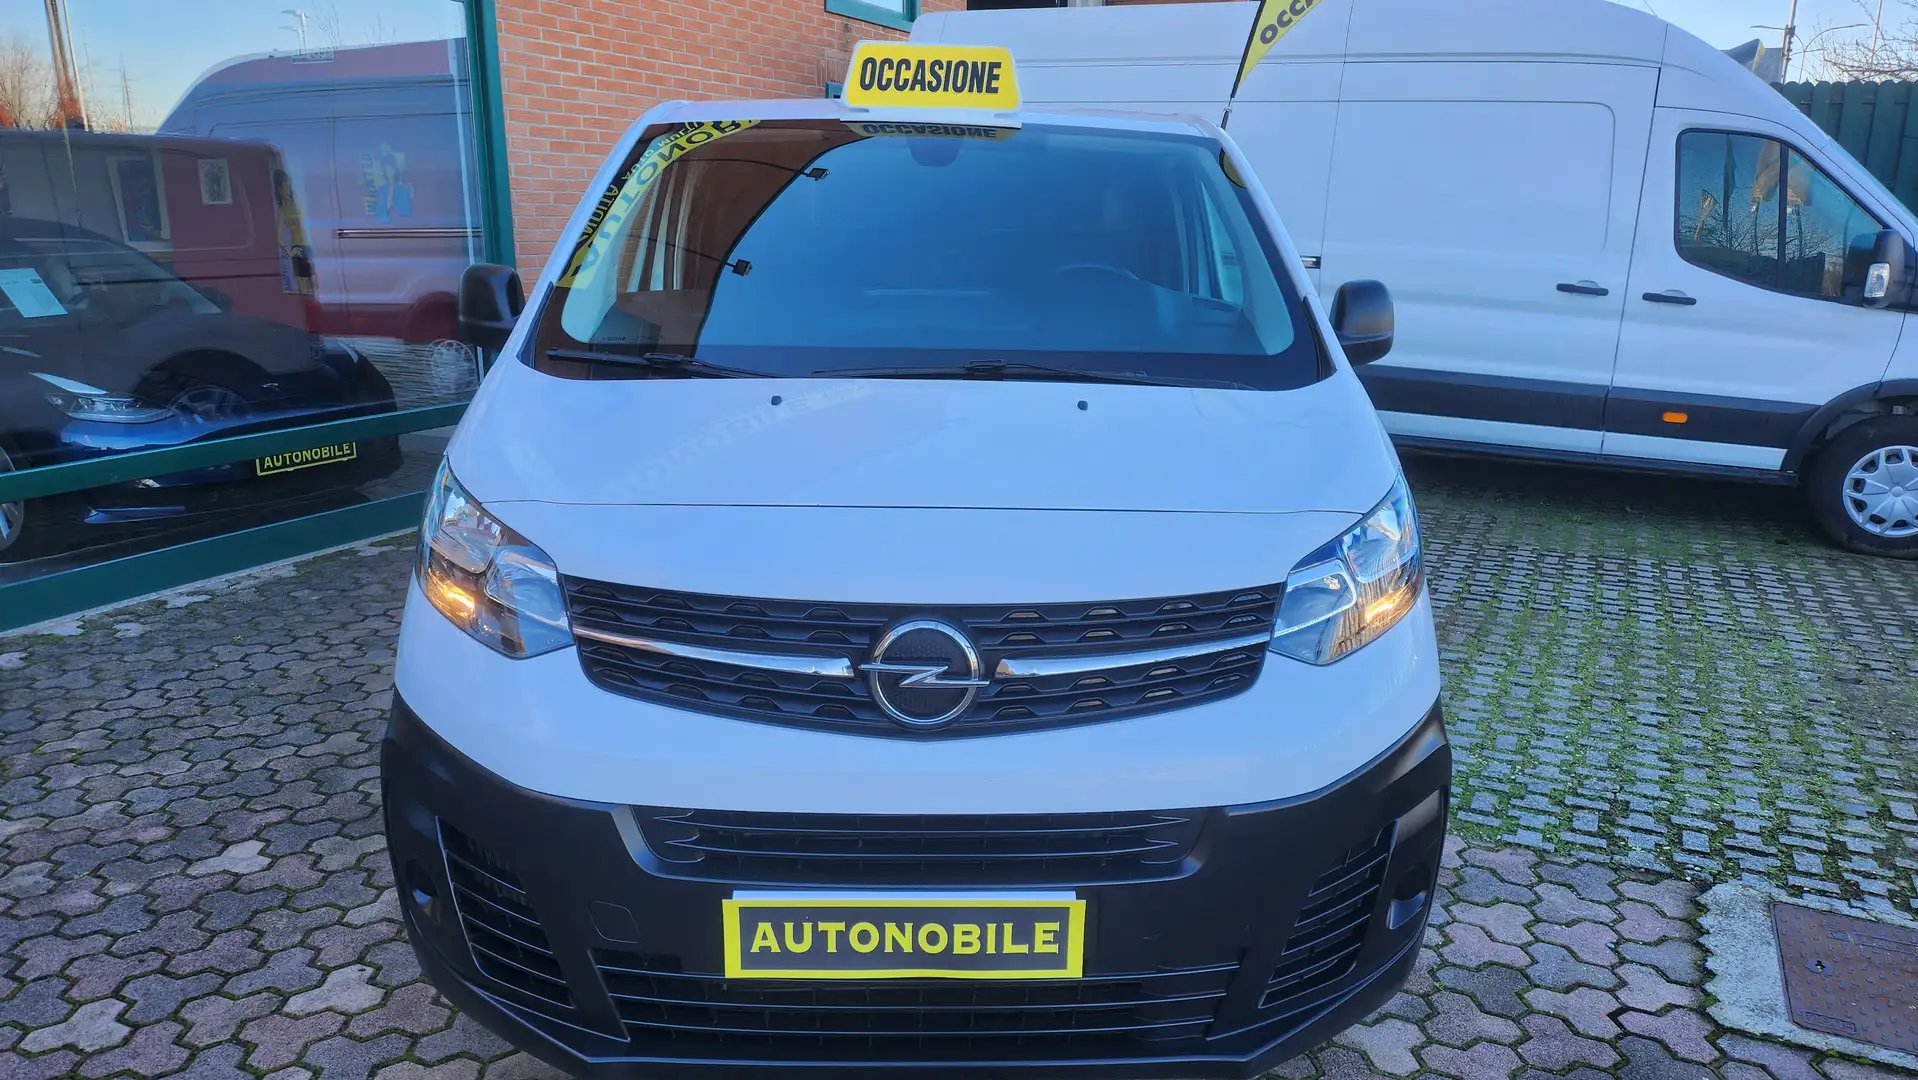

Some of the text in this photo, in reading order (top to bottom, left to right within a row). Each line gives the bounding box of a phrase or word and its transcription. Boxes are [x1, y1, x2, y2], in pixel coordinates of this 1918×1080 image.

[860, 57, 1002, 93] OCCASIONE
[264, 443, 350, 469] AUTONOBILE
[750, 921, 1060, 955] AUTONOBILE
